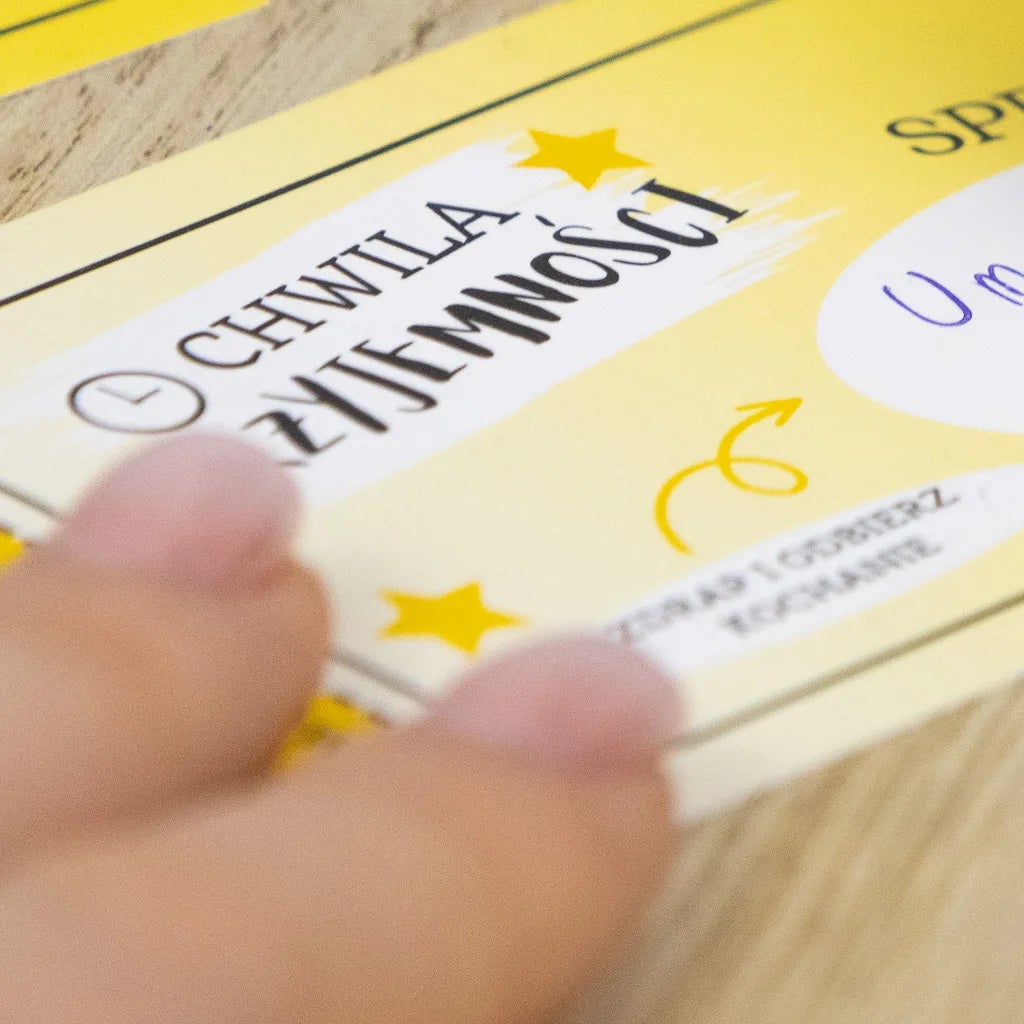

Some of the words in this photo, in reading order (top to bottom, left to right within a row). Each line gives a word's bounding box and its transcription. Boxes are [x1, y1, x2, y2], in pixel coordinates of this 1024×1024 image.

[175, 198, 521, 370] CHWILA
[240, 178, 748, 467] ZYJEMNOŚCI
[717, 537, 944, 638] KOCHANIE
[776, 484, 962, 569] ODBIERZ
